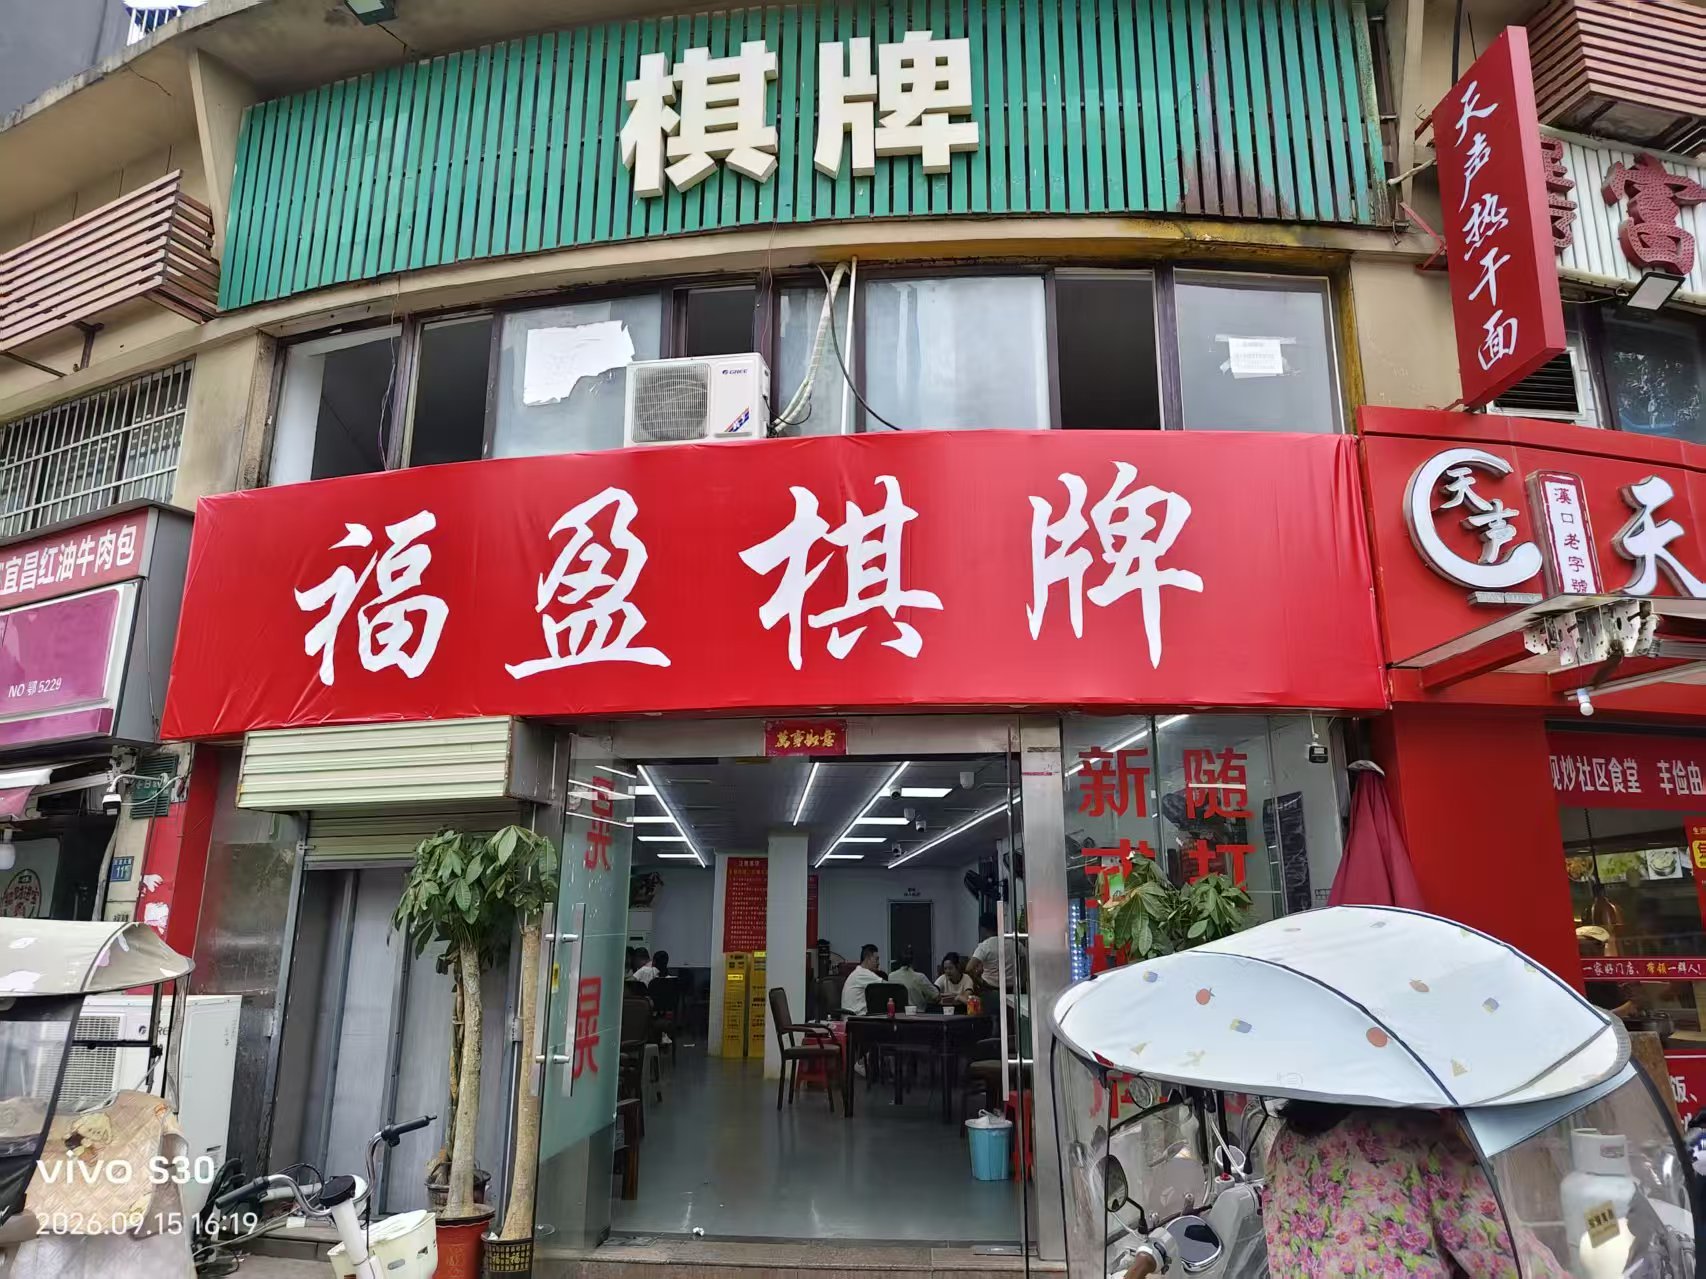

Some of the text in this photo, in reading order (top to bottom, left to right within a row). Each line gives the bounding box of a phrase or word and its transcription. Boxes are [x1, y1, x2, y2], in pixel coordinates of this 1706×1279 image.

[620, 31, 979, 198] 棋牌
[1455, 80, 1518, 371] 天声热干面
[294, 461, 1204, 685] 福盈棋牌
[1622, 475, 1706, 597] 天
